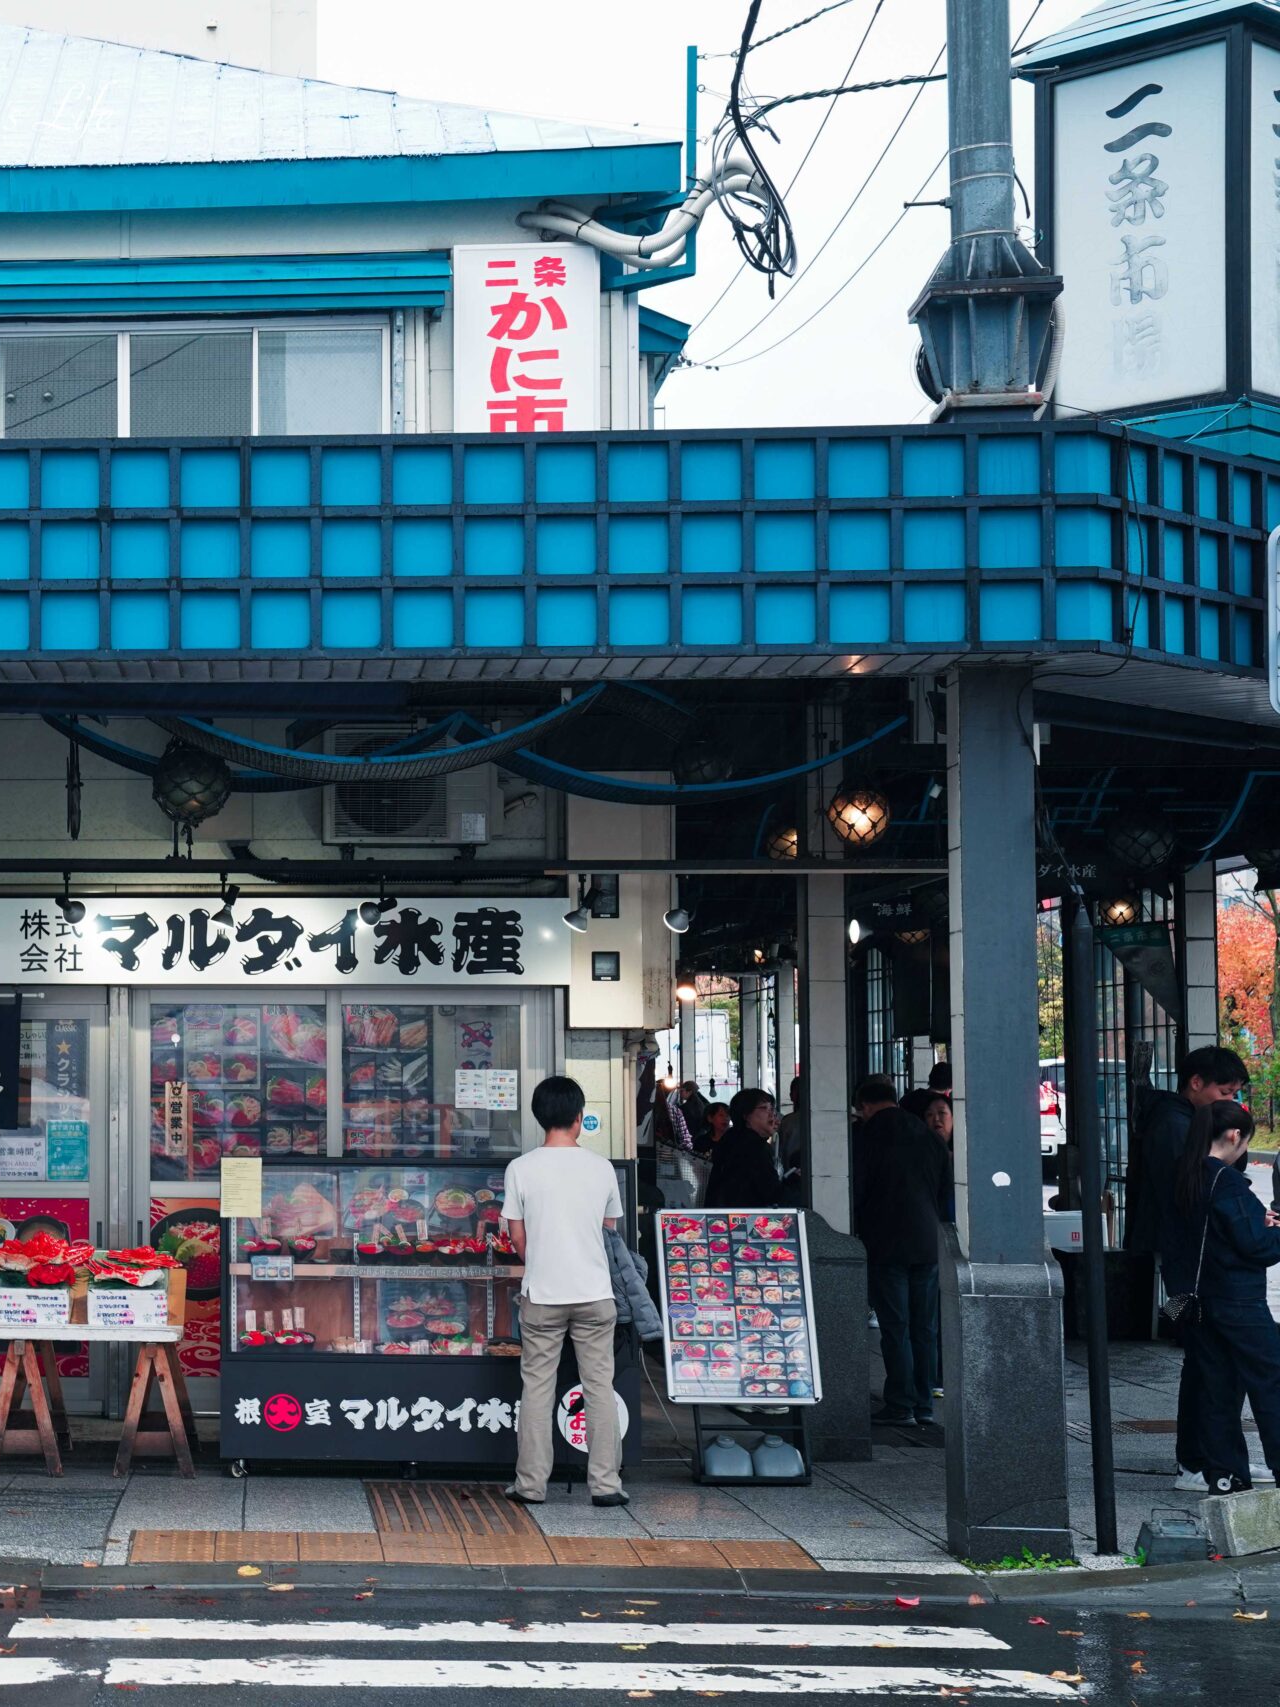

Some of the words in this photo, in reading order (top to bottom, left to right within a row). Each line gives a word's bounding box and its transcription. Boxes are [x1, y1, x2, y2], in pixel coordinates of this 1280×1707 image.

[485, 256, 567, 287] 二条
[486, 291, 568, 432] かに市
[20, 908, 84, 939] 株式
[94, 906, 526, 975] マルダイ水産
[20, 943, 84, 974] 会社
[54, 1024, 77, 1032] CLASSIC
[170, 1101, 183, 1145] 営業中
[339, 1396, 521, 1433] マルダイ水
